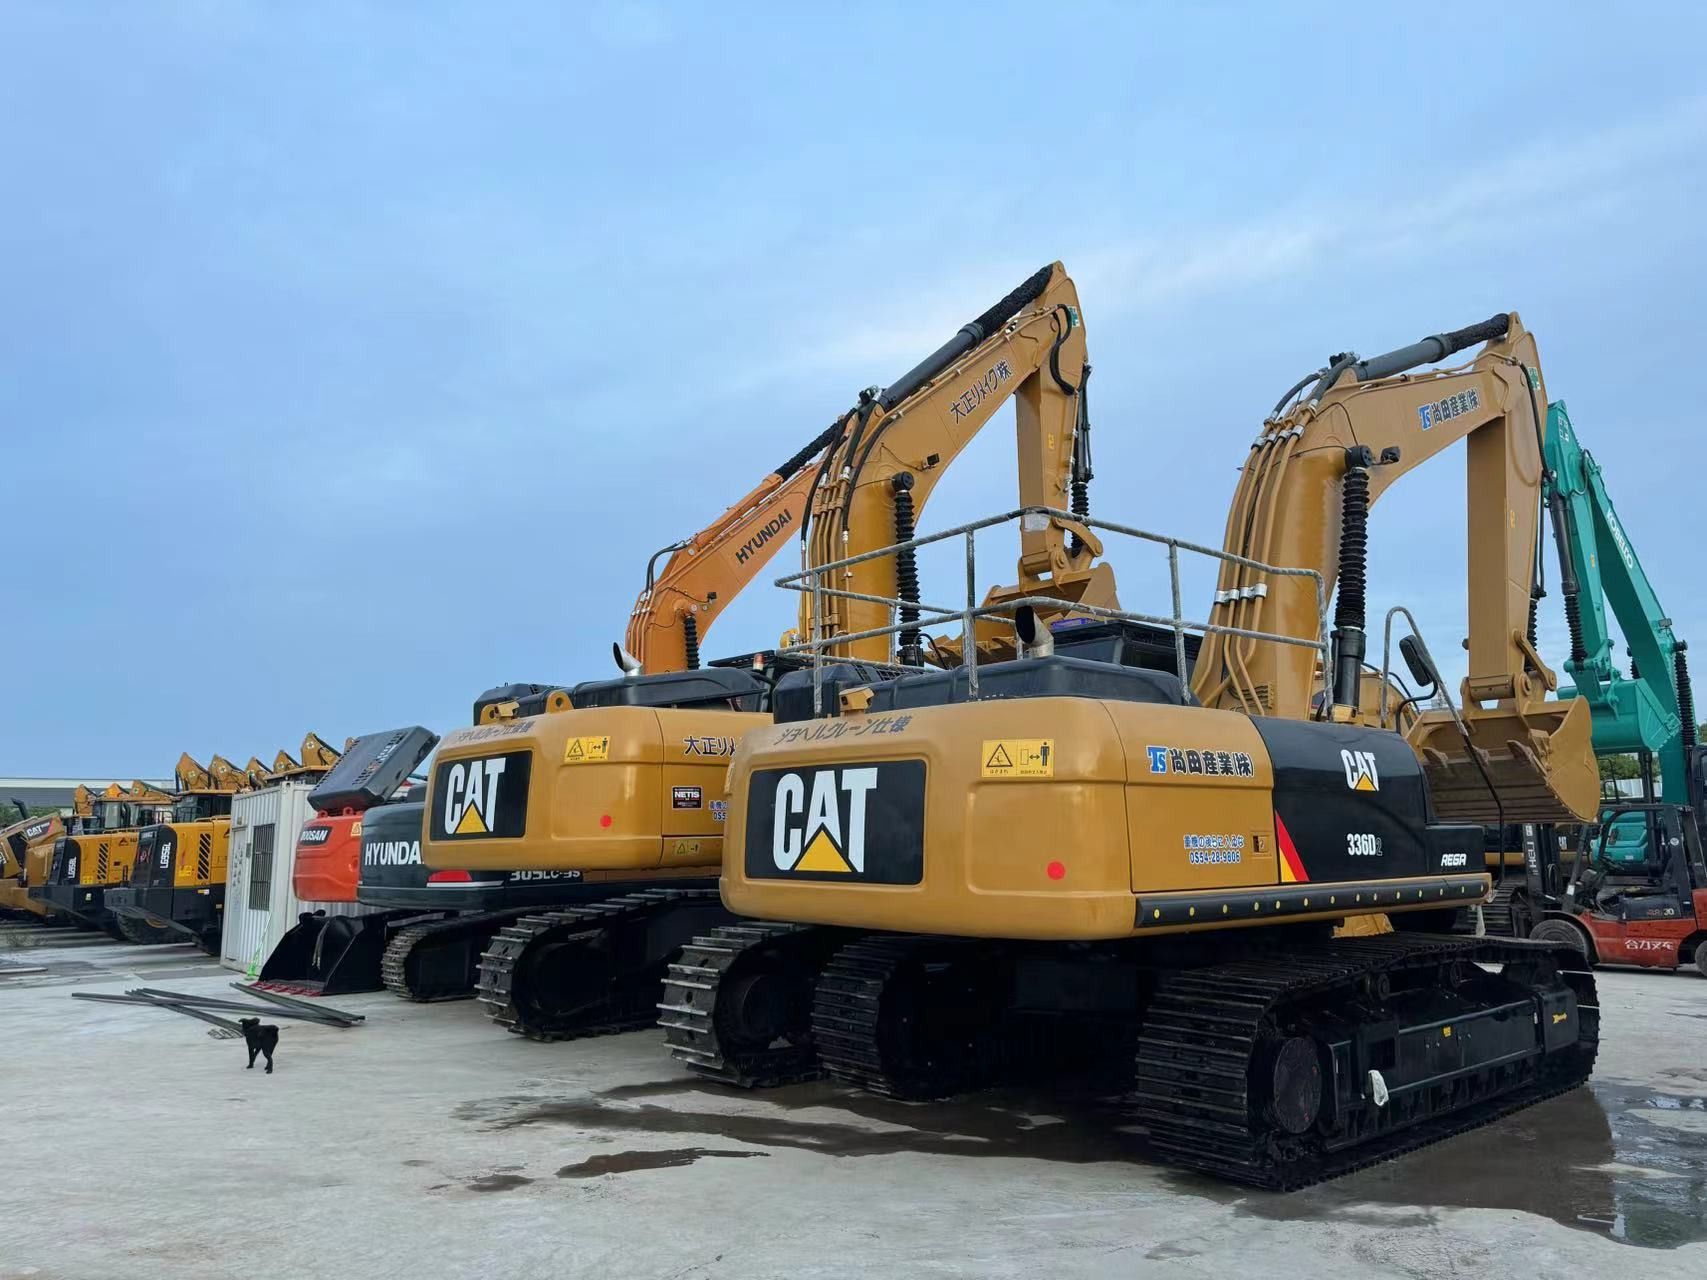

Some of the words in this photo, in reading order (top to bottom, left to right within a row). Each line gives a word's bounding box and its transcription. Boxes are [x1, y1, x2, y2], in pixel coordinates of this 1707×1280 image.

[736, 509, 793, 565] HYUNDAI
[444, 757, 506, 834] CAT
[1340, 749, 1380, 791] CAT
[773, 767, 878, 873] CAT
[364, 840, 425, 866] HYUNDA
